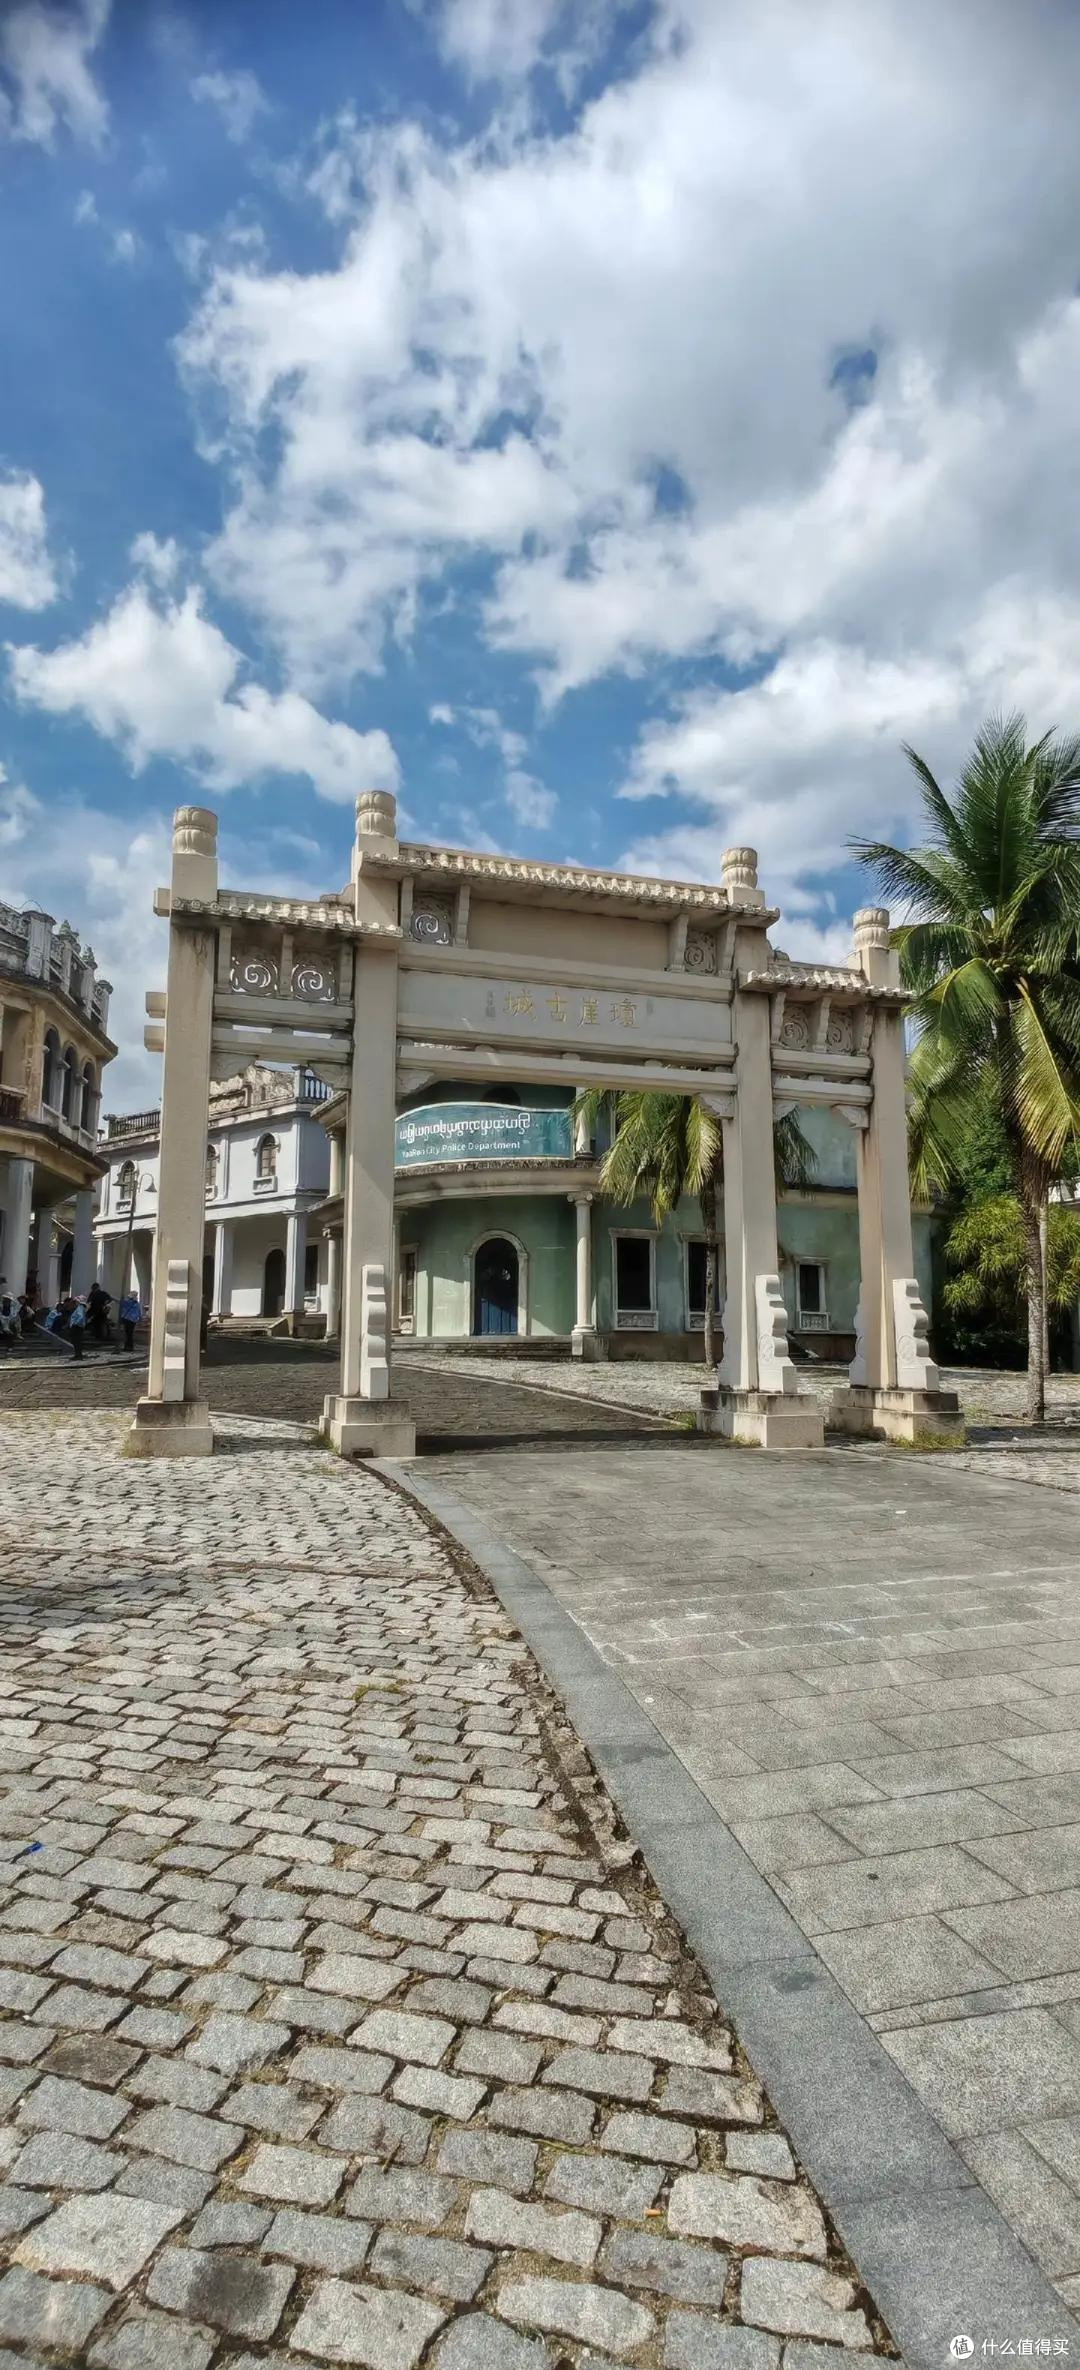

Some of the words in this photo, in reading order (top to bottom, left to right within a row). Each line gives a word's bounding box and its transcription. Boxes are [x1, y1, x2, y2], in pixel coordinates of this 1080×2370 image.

[426, 1145, 440, 1155] City
[441, 1143, 466, 1153] Police
[467, 1141, 521, 1152] Department
